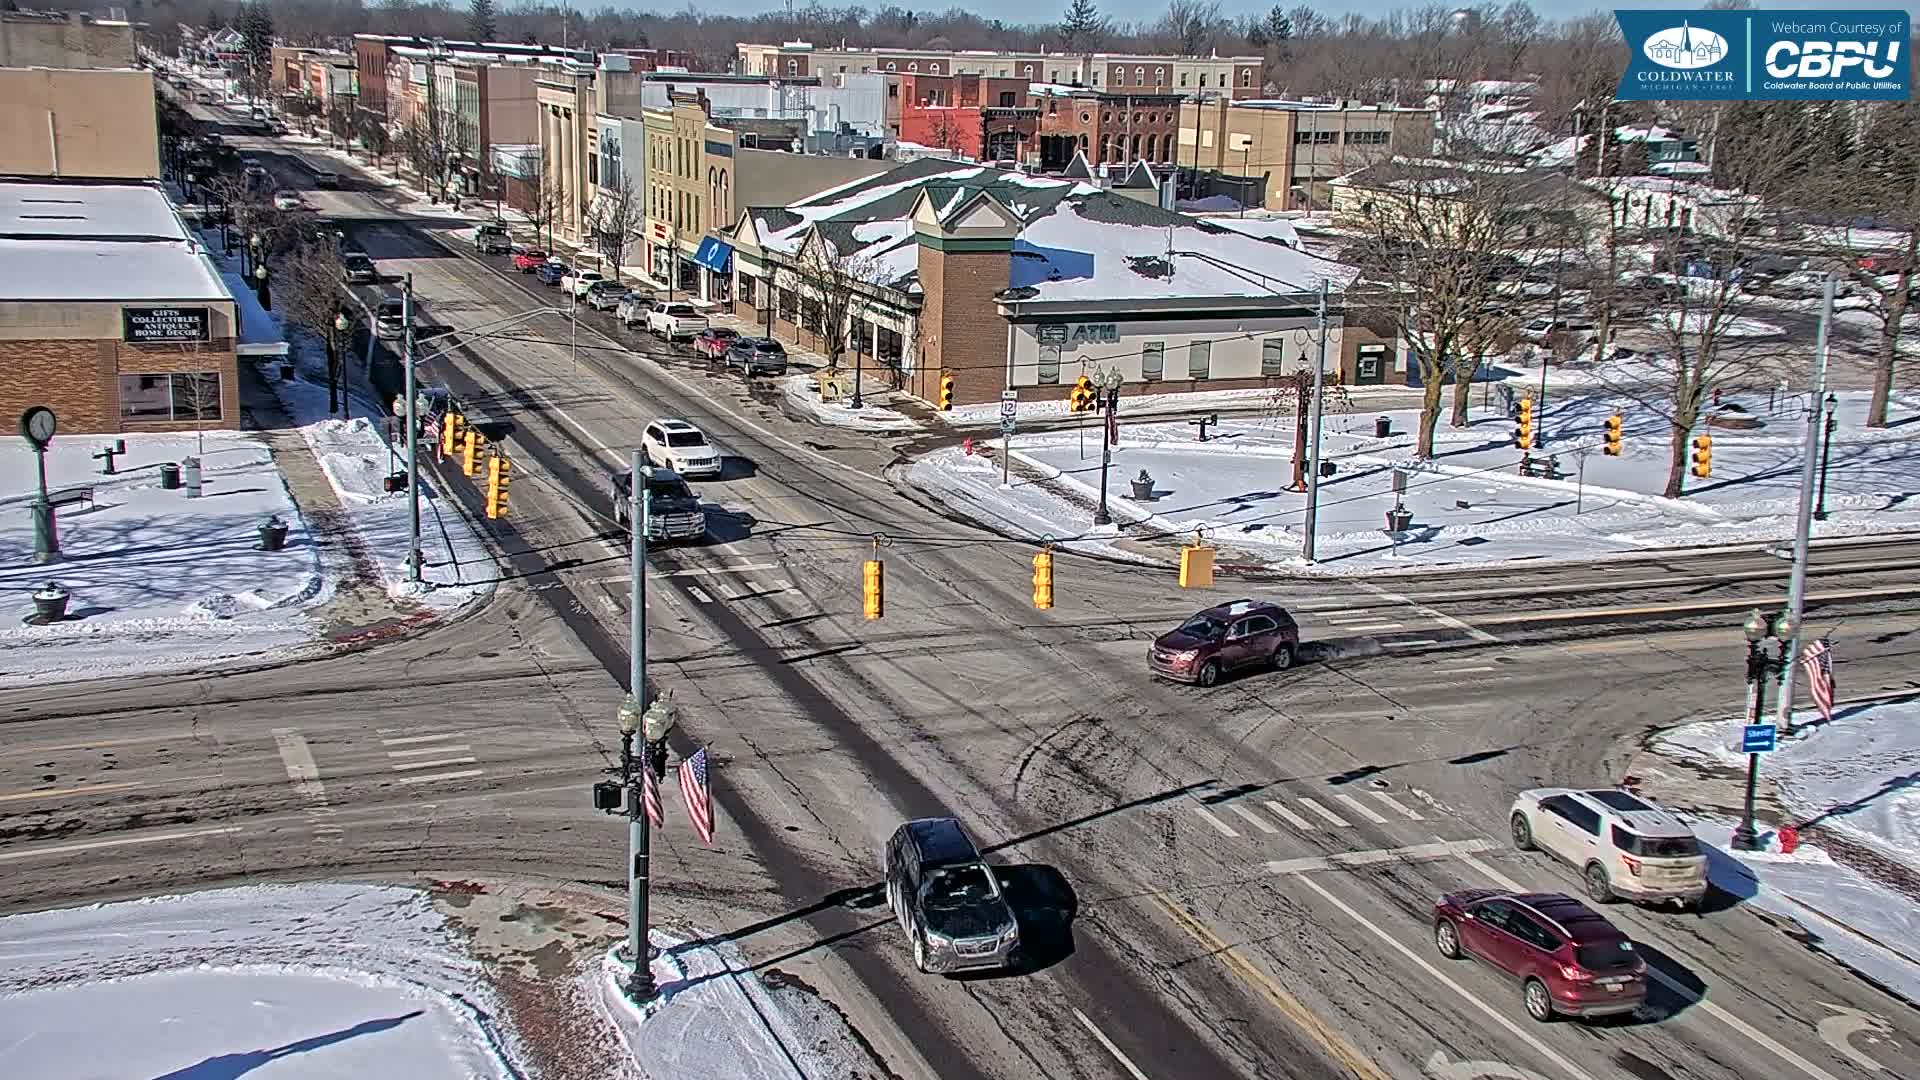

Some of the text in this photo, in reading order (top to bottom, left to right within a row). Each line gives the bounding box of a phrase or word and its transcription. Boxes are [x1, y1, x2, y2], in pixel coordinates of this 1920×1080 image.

[135, 329, 163, 337] HOME
[1072, 324, 1117, 341] ATM
[1004, 403, 1014, 412] 12
